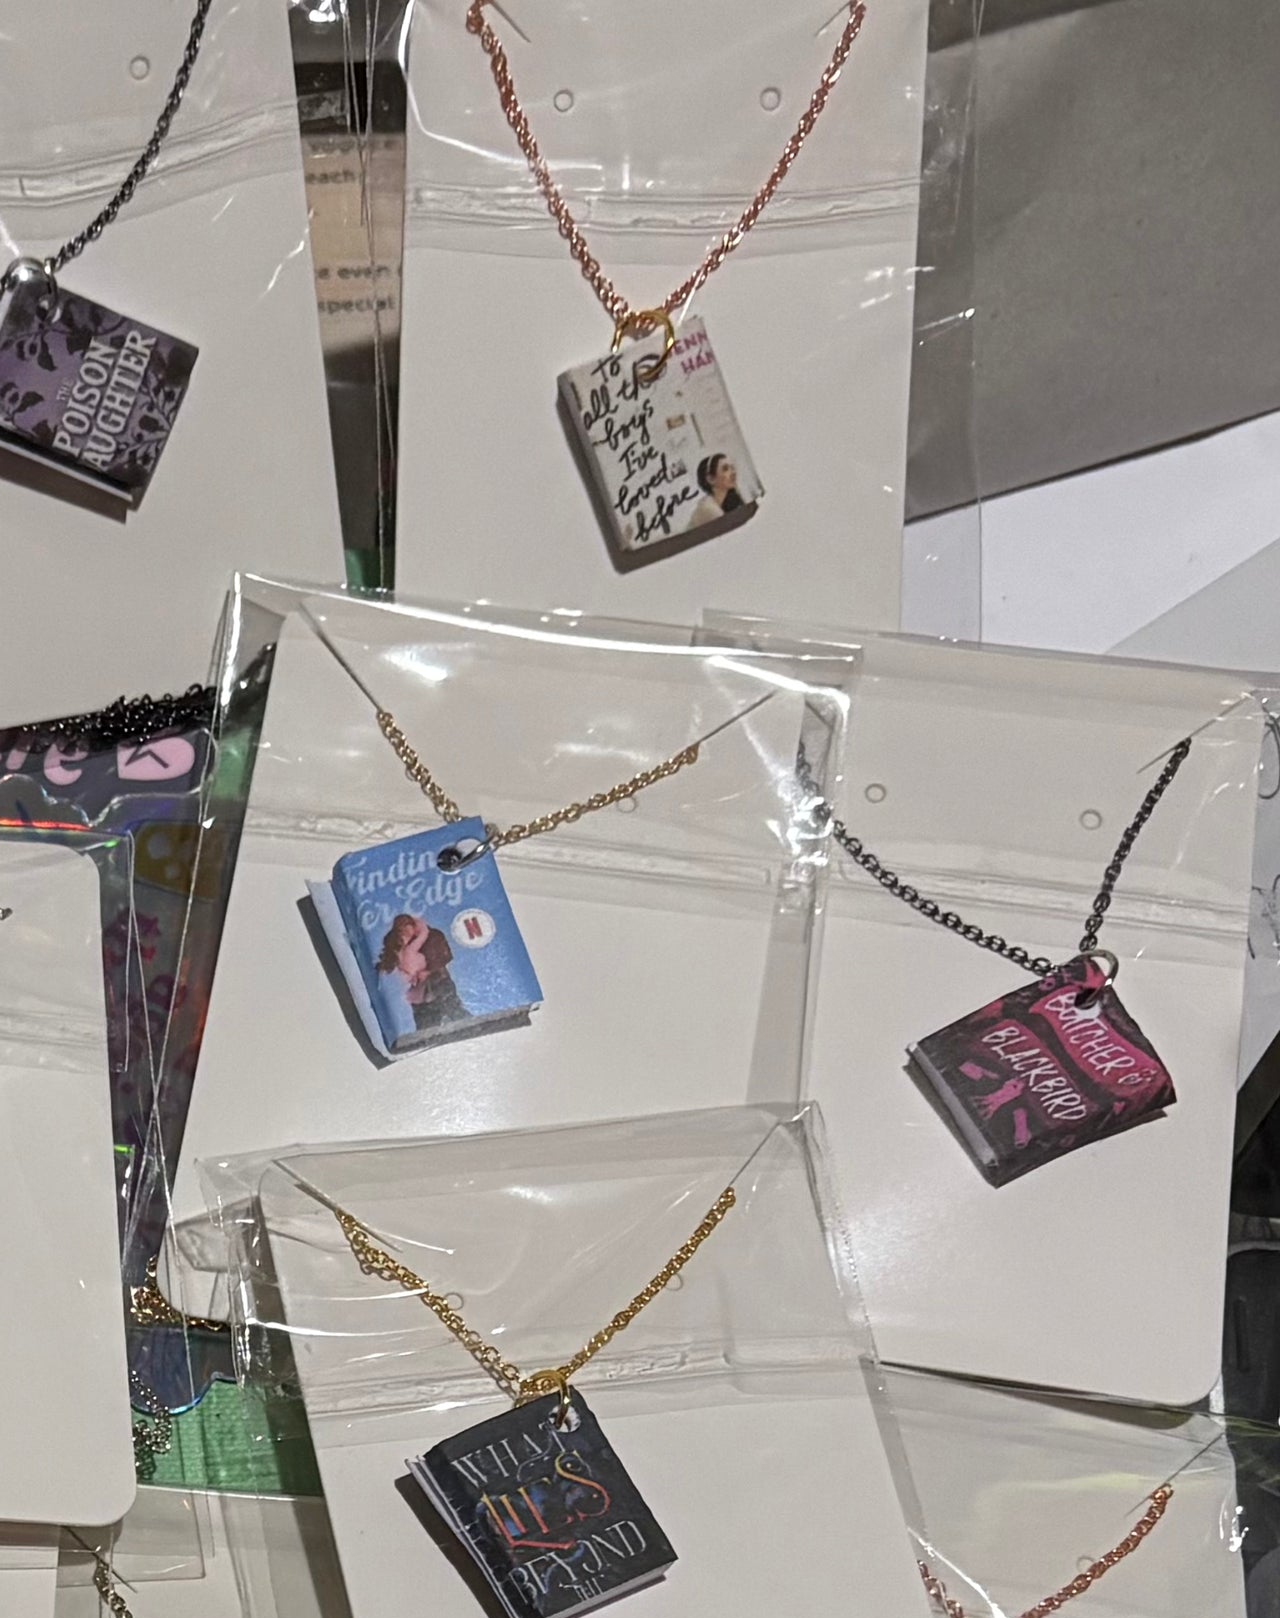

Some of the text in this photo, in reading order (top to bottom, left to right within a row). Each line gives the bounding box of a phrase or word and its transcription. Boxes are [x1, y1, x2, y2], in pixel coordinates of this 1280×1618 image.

[592, 353, 623, 383] To
[53, 337, 118, 458] POISON
[583, 385, 619, 431] all
[592, 399, 654, 451] boys
[614, 454, 668, 515] loved
[619, 440, 658, 481] I've
[634, 487, 699, 541] before
[343, 849, 443, 897] Findin
[394, 870, 484, 916] Edge
[982, 1026, 1087, 1121] BLACKBIRD
[450, 1421, 568, 1490] WHAT
